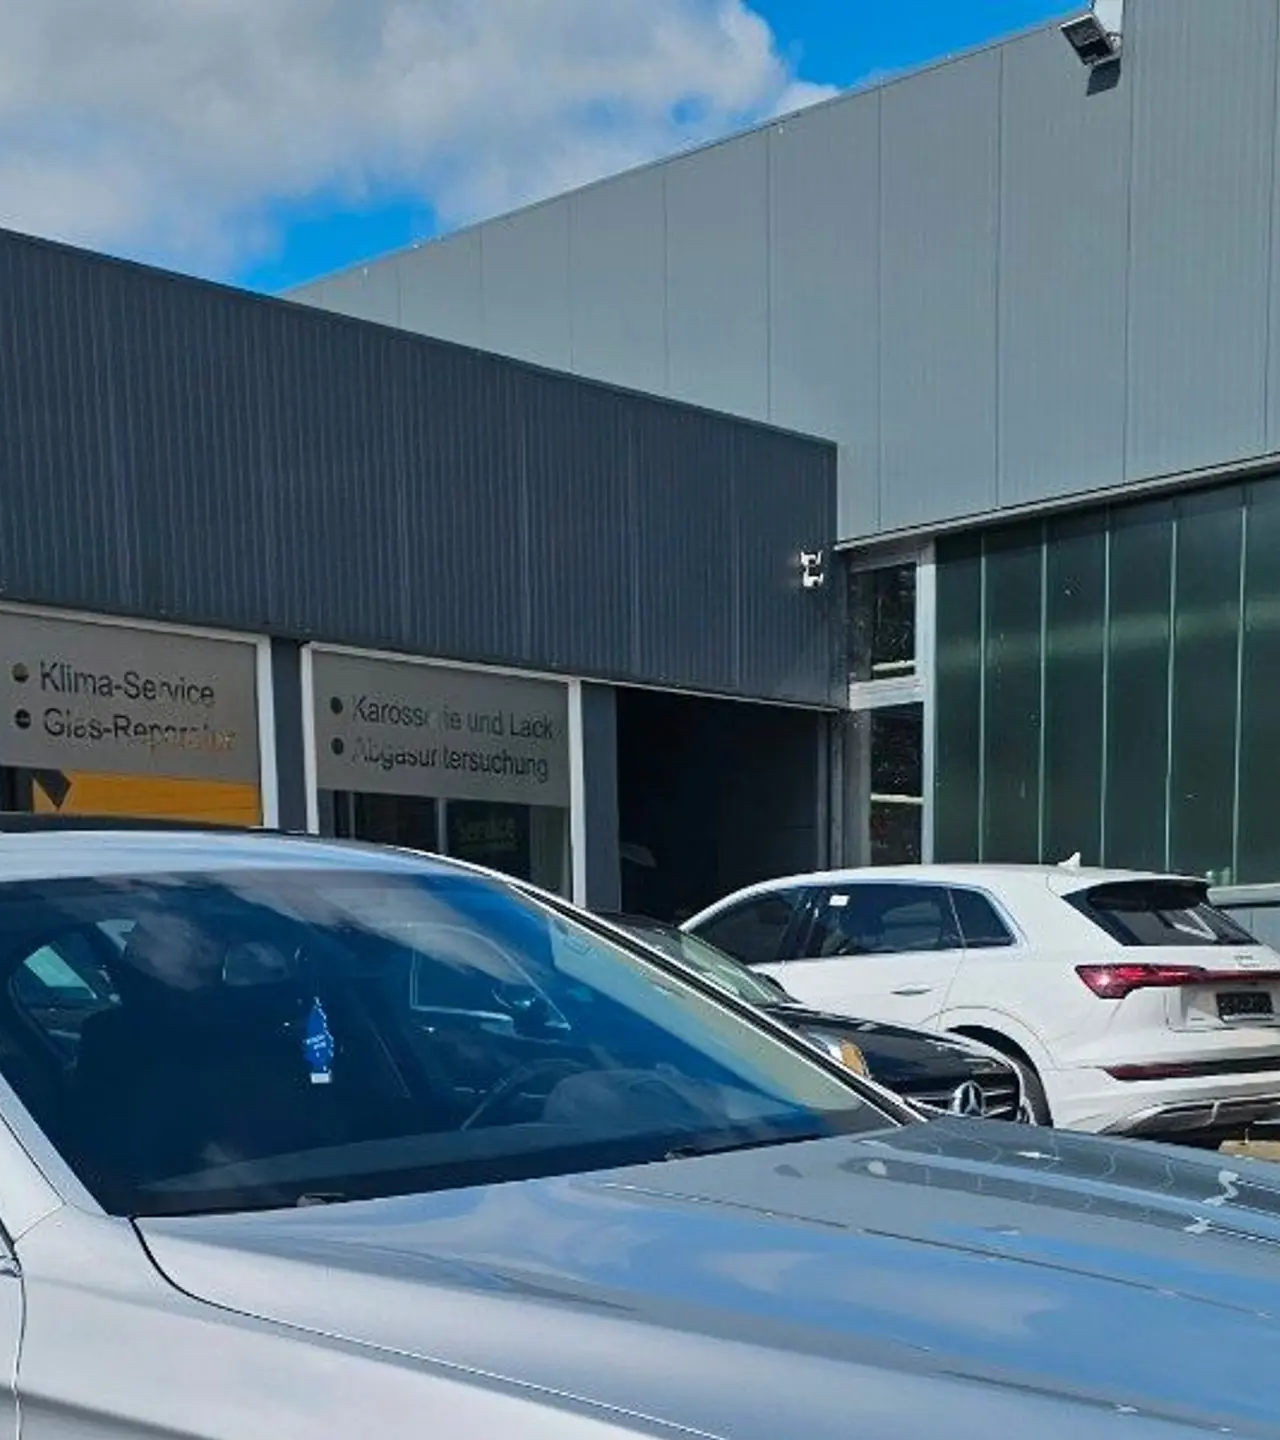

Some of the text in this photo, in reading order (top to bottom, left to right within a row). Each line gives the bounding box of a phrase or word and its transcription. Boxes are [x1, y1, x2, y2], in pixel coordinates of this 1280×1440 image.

[39, 661, 215, 703] Klima-Service
[469, 711, 503, 737] und
[509, 713, 553, 740] Lack
